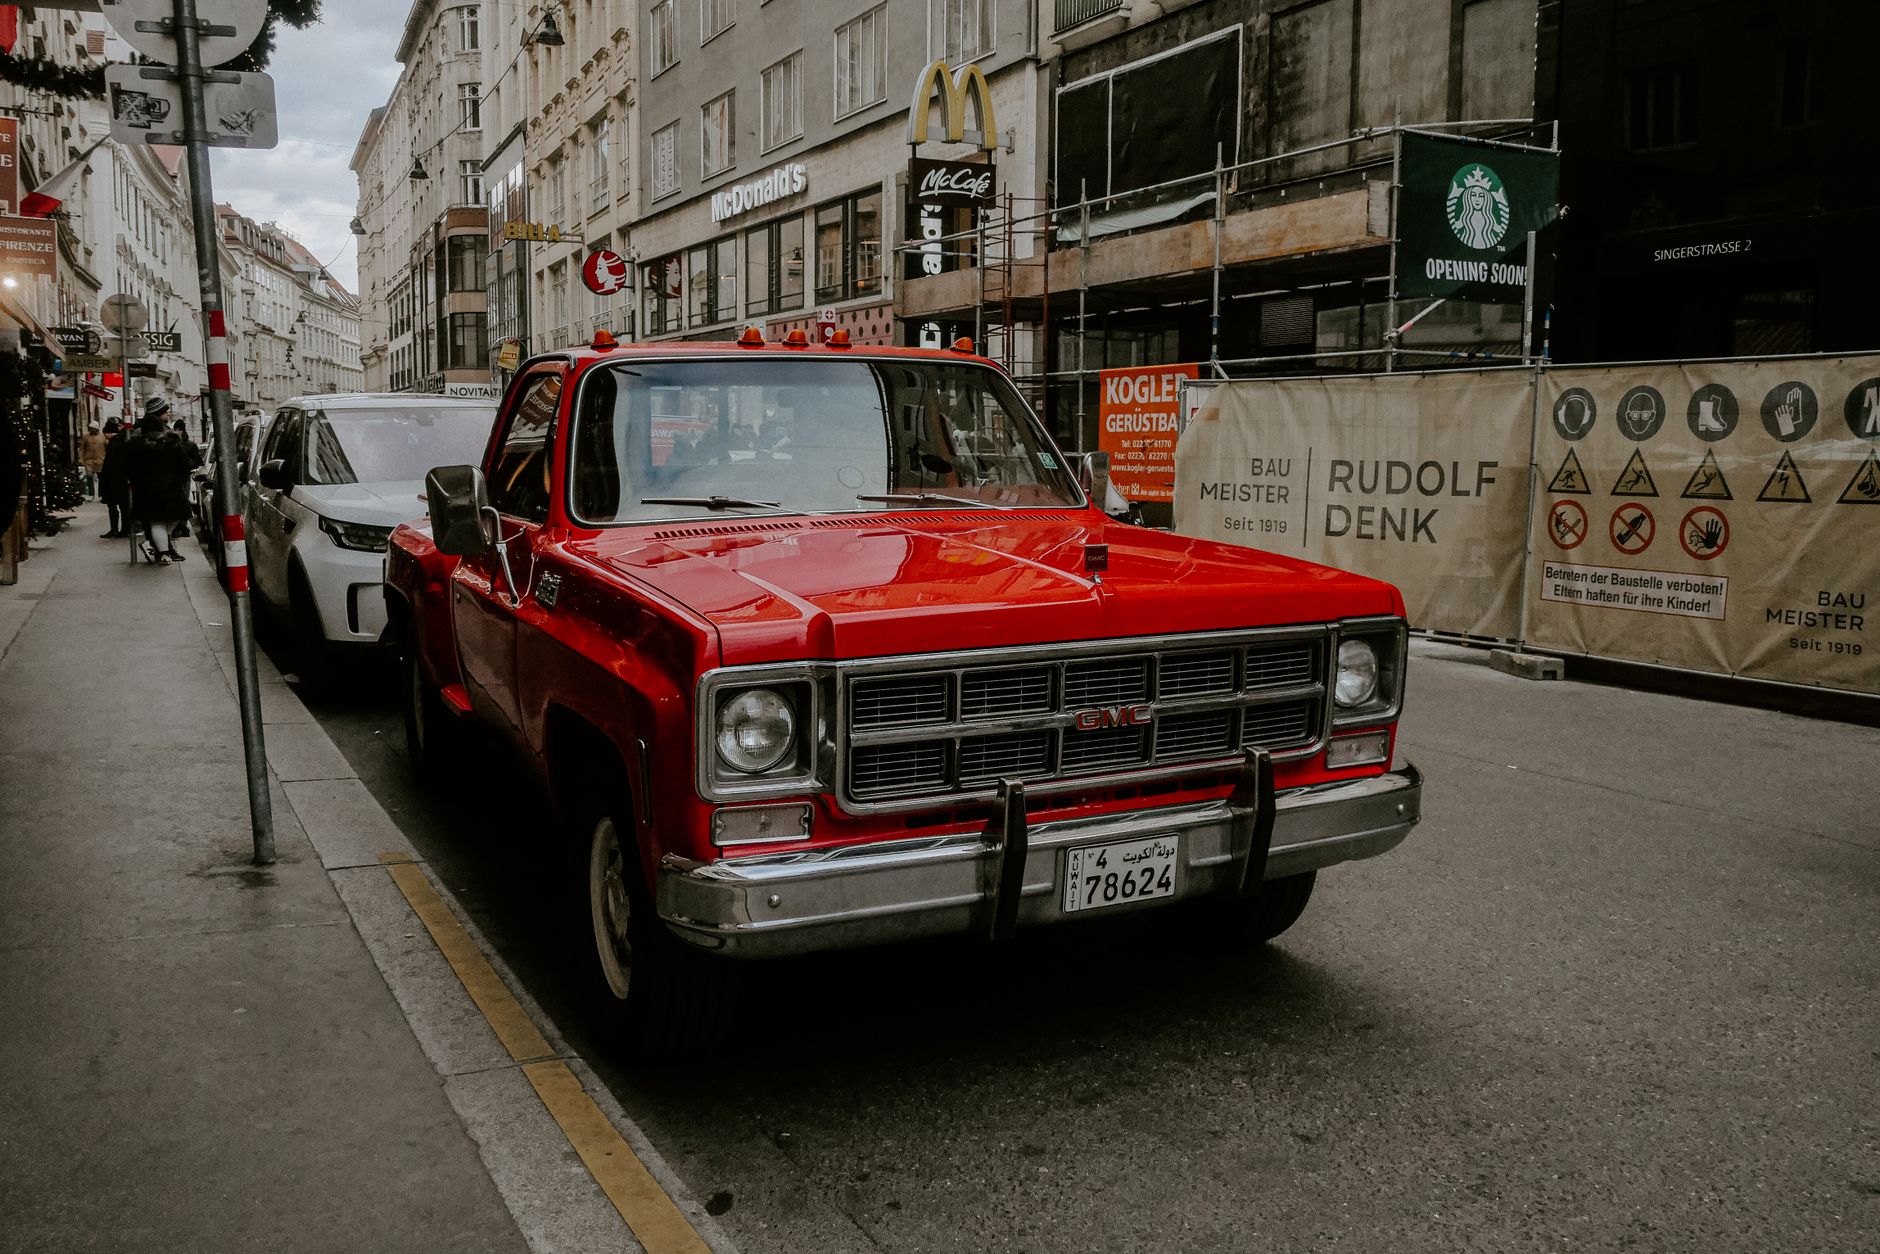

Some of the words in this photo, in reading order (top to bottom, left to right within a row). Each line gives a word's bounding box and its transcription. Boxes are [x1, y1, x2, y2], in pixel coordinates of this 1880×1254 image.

[711, 162, 807, 223] McDonald's
[919, 167, 991, 199] McCafé
[504, 221, 561, 242] BILLA
[0, 240, 54, 252] FIRENZE
[1654, 240, 1741, 261] SINGERSTRASSE
[1744, 239, 1752, 251] 2
[1426, 258, 1488, 283] OPENING
[70, 359, 110, 368] AMBER
[1106, 408, 1178, 432] GERÜSTBA
[1251, 458, 1291, 477] BAU
[1328, 460, 1498, 497] RUDOLF
[1200, 482, 1289, 503] MEISTER
[1224, 517, 1254, 531] Seit
[1259, 519, 1287, 534] 1919
[1325, 504, 1439, 544] DENK
[1546, 566, 1587, 584] Betreten
[1590, 571, 1608, 585] der
[1611, 573, 1662, 590] Baustelle
[1666, 579, 1723, 596] verboten!
[1554, 584, 1582, 599] Eltern
[1586, 588, 1620, 603] haften
[1623, 591, 1639, 606] für
[1641, 593, 1663, 608] ihre
[1666, 596, 1711, 613] Kinder!
[1818, 591, 1865, 609] BAU
[1766, 608, 1864, 631] MEISTER
[1790, 638, 1821, 652] Seit
[1828, 641, 1862, 655] 1919
[1074, 704, 1152, 730] GMC
[1096, 849, 1107, 869] 4
[1071, 853, 1079, 909] KUWAIT
[1086, 864, 1171, 904] 78624
